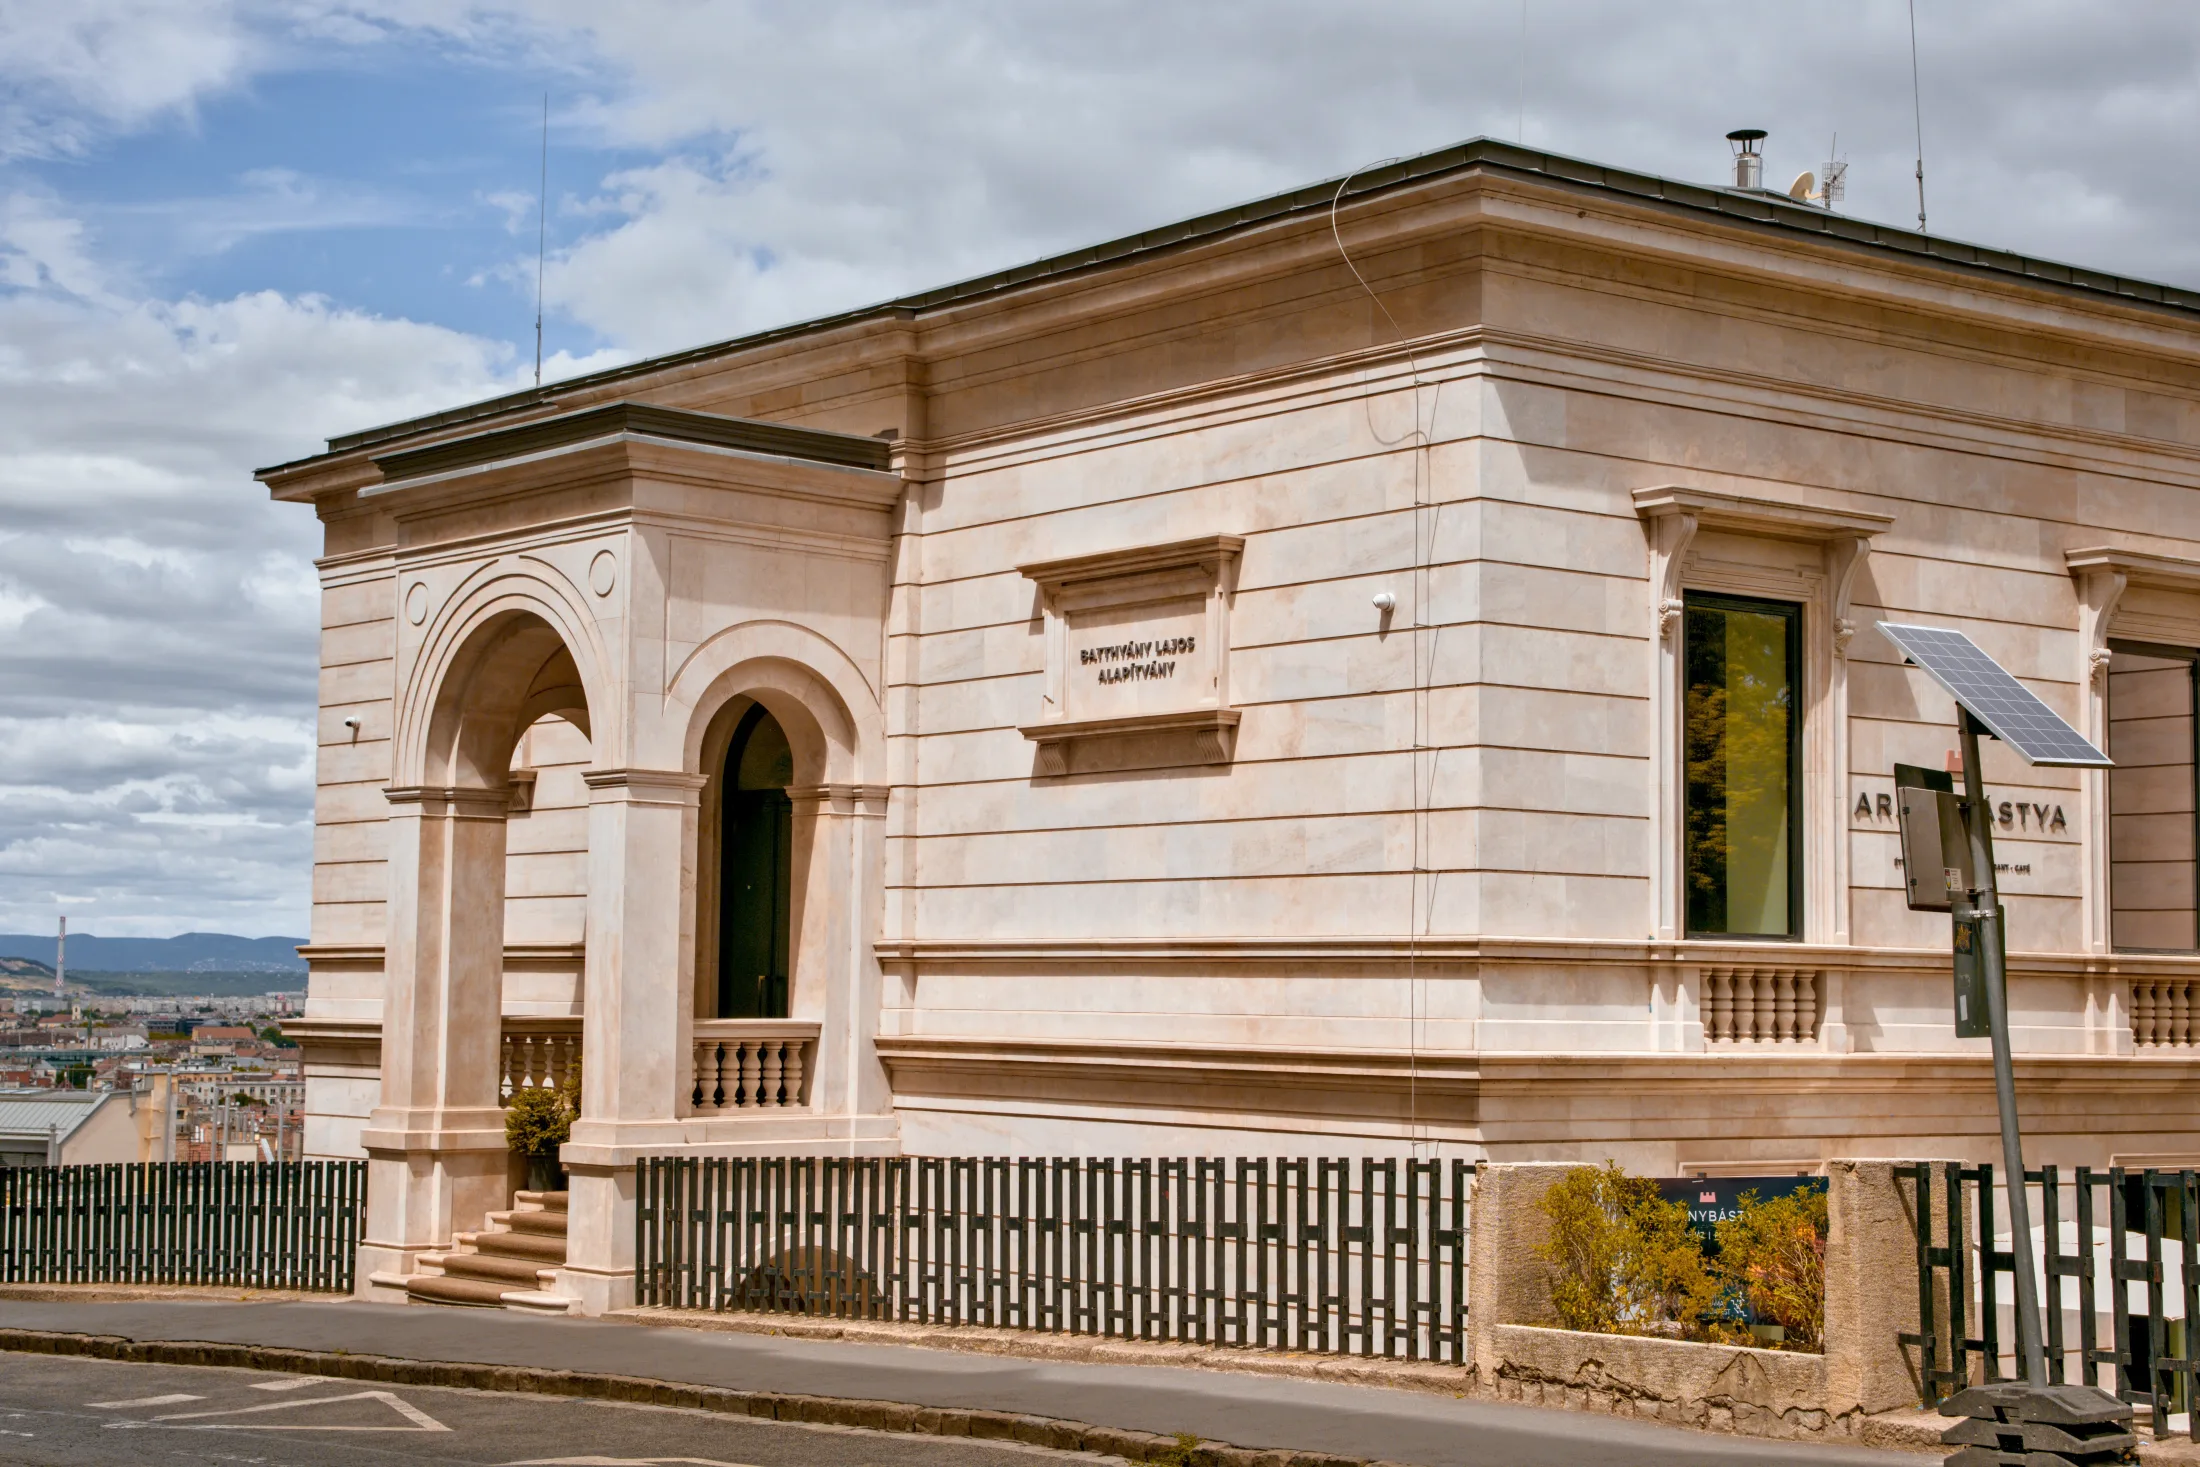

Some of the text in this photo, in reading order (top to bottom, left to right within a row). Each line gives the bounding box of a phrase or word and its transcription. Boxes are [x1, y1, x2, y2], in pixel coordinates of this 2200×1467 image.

[1080, 637, 1195, 665] BATTHYÁNY LAJOS
[1098, 660, 1176, 685] ALAPÍTVÁNY
